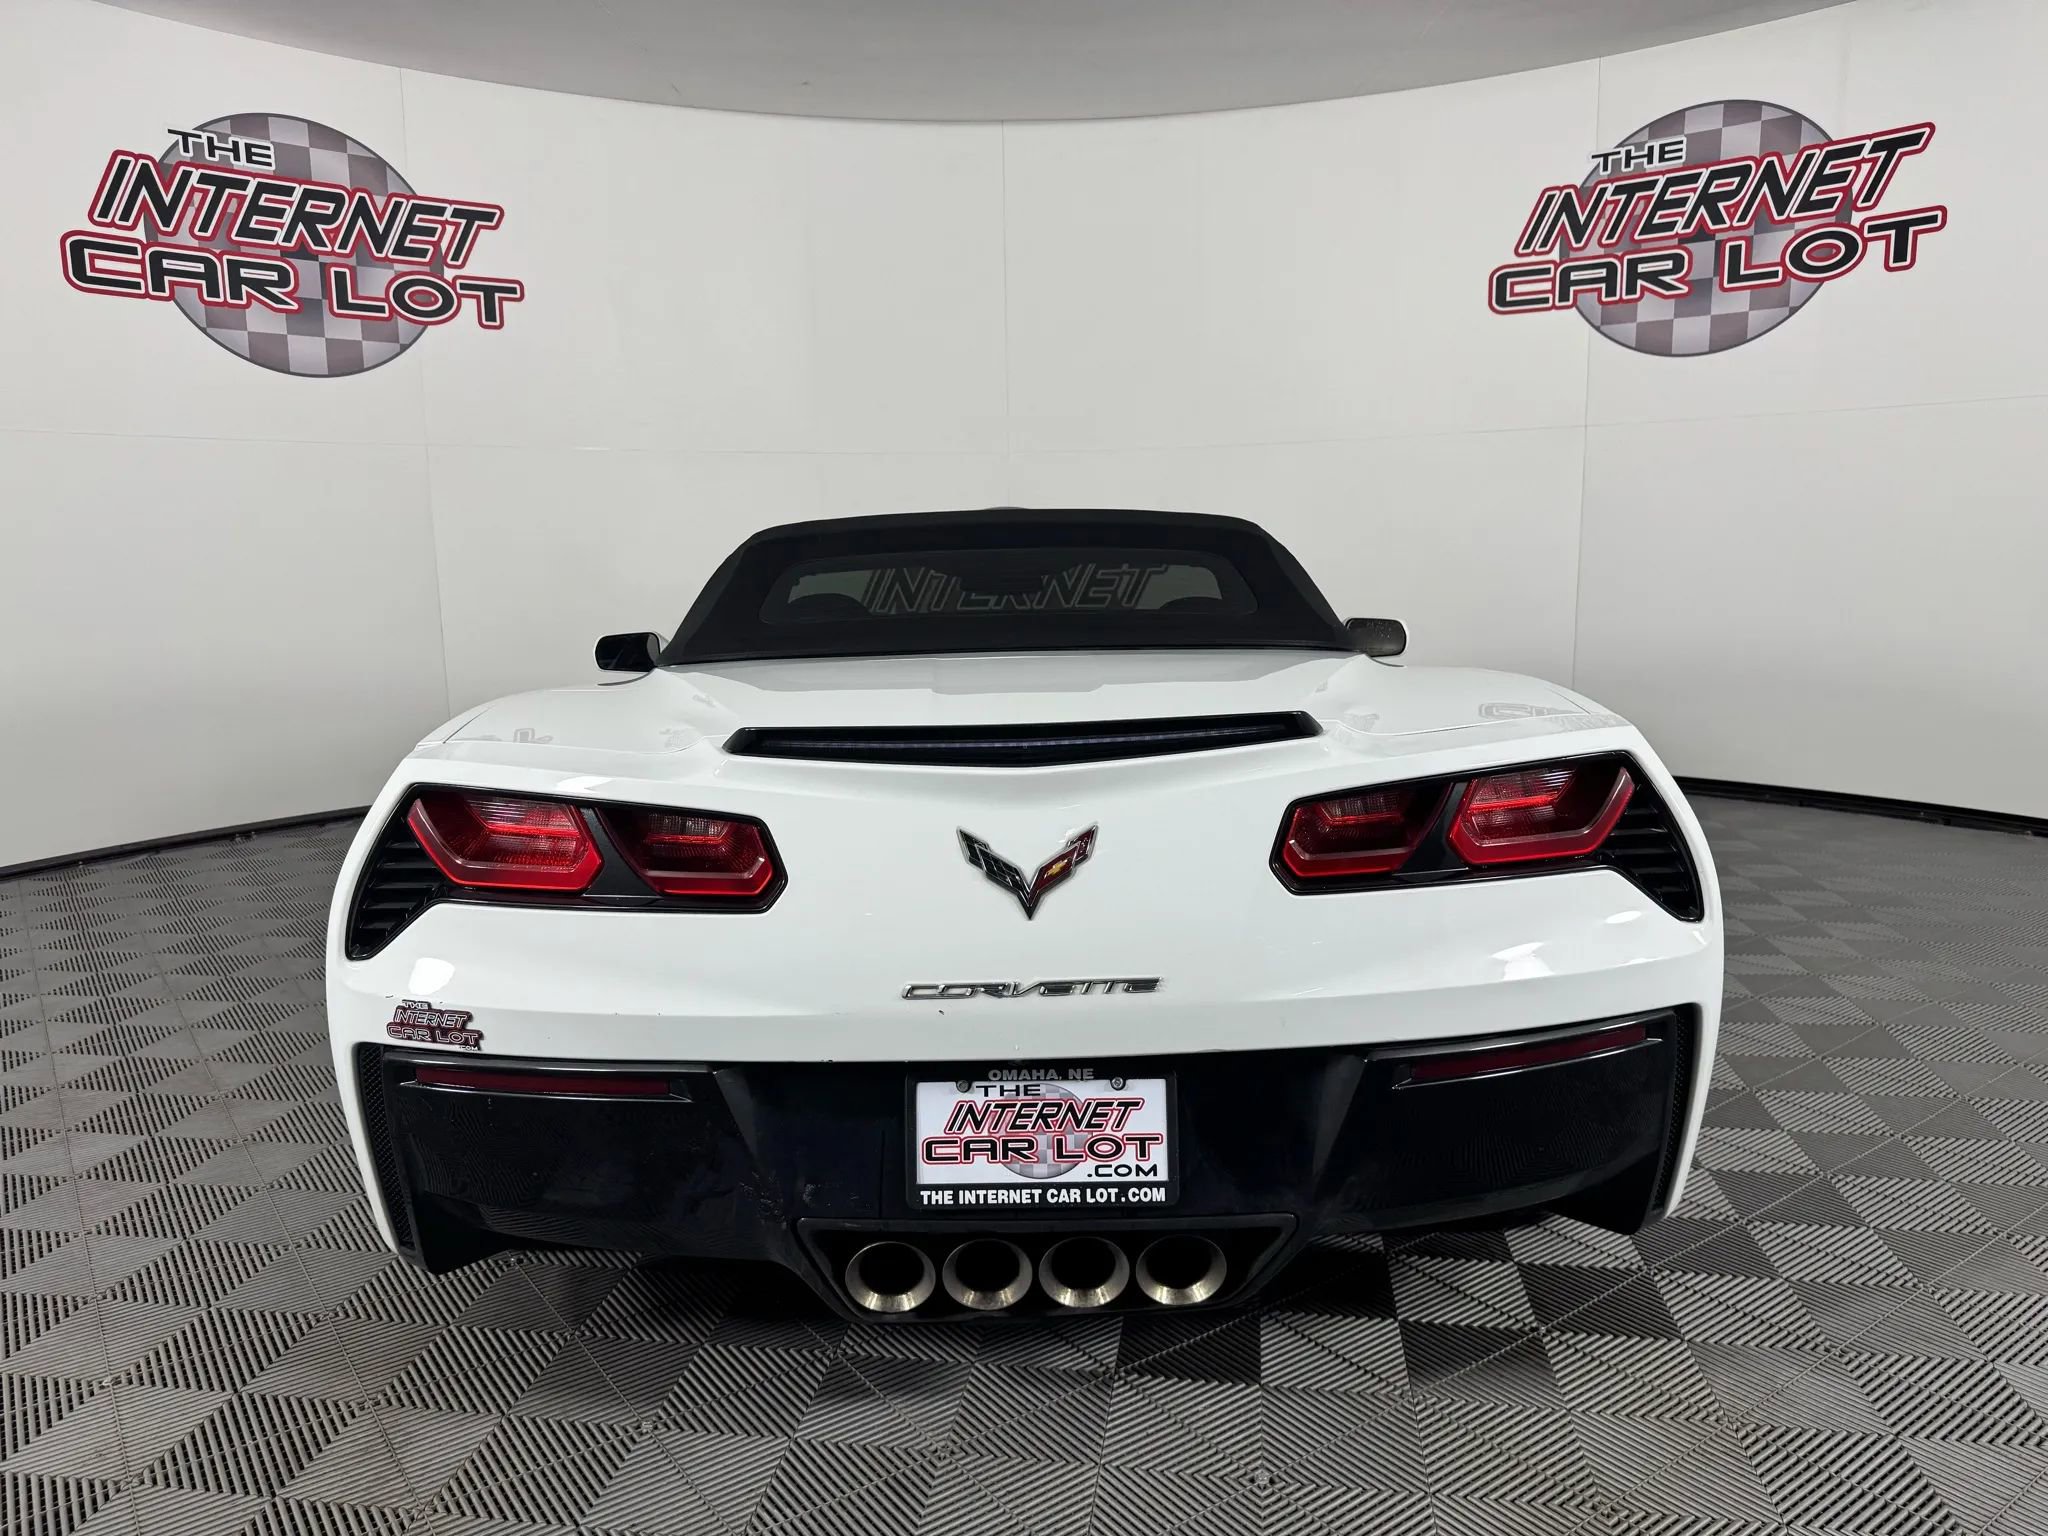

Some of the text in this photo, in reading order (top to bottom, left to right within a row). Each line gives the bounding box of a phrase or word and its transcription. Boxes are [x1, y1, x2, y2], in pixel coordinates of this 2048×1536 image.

[167, 127, 275, 169] THE
[1592, 136, 1685, 174] THE
[1517, 124, 1932, 255] INTERNET
[92, 152, 501, 265] INTERNET
[1492, 208, 1945, 312] CAR LOT
[65, 234, 522, 328] CAR LOT
[902, 976, 1162, 999] CORVETTE
[394, 1008, 468, 1028] INTERNET
[387, 1025, 479, 1045] CAR LOT
[988, 1068, 1095, 1081] OMAHA, NE
[976, 1084, 1041, 1097] THE
[945, 1099, 1143, 1133] INTERNET
[923, 1134, 1162, 1163] CAR LOT
[1087, 1164, 1158, 1177] .COM
[920, 1190, 953, 1205] THE
[959, 1189, 1042, 1204] INTERNET
[1046, 1188, 1081, 1203] CAR
